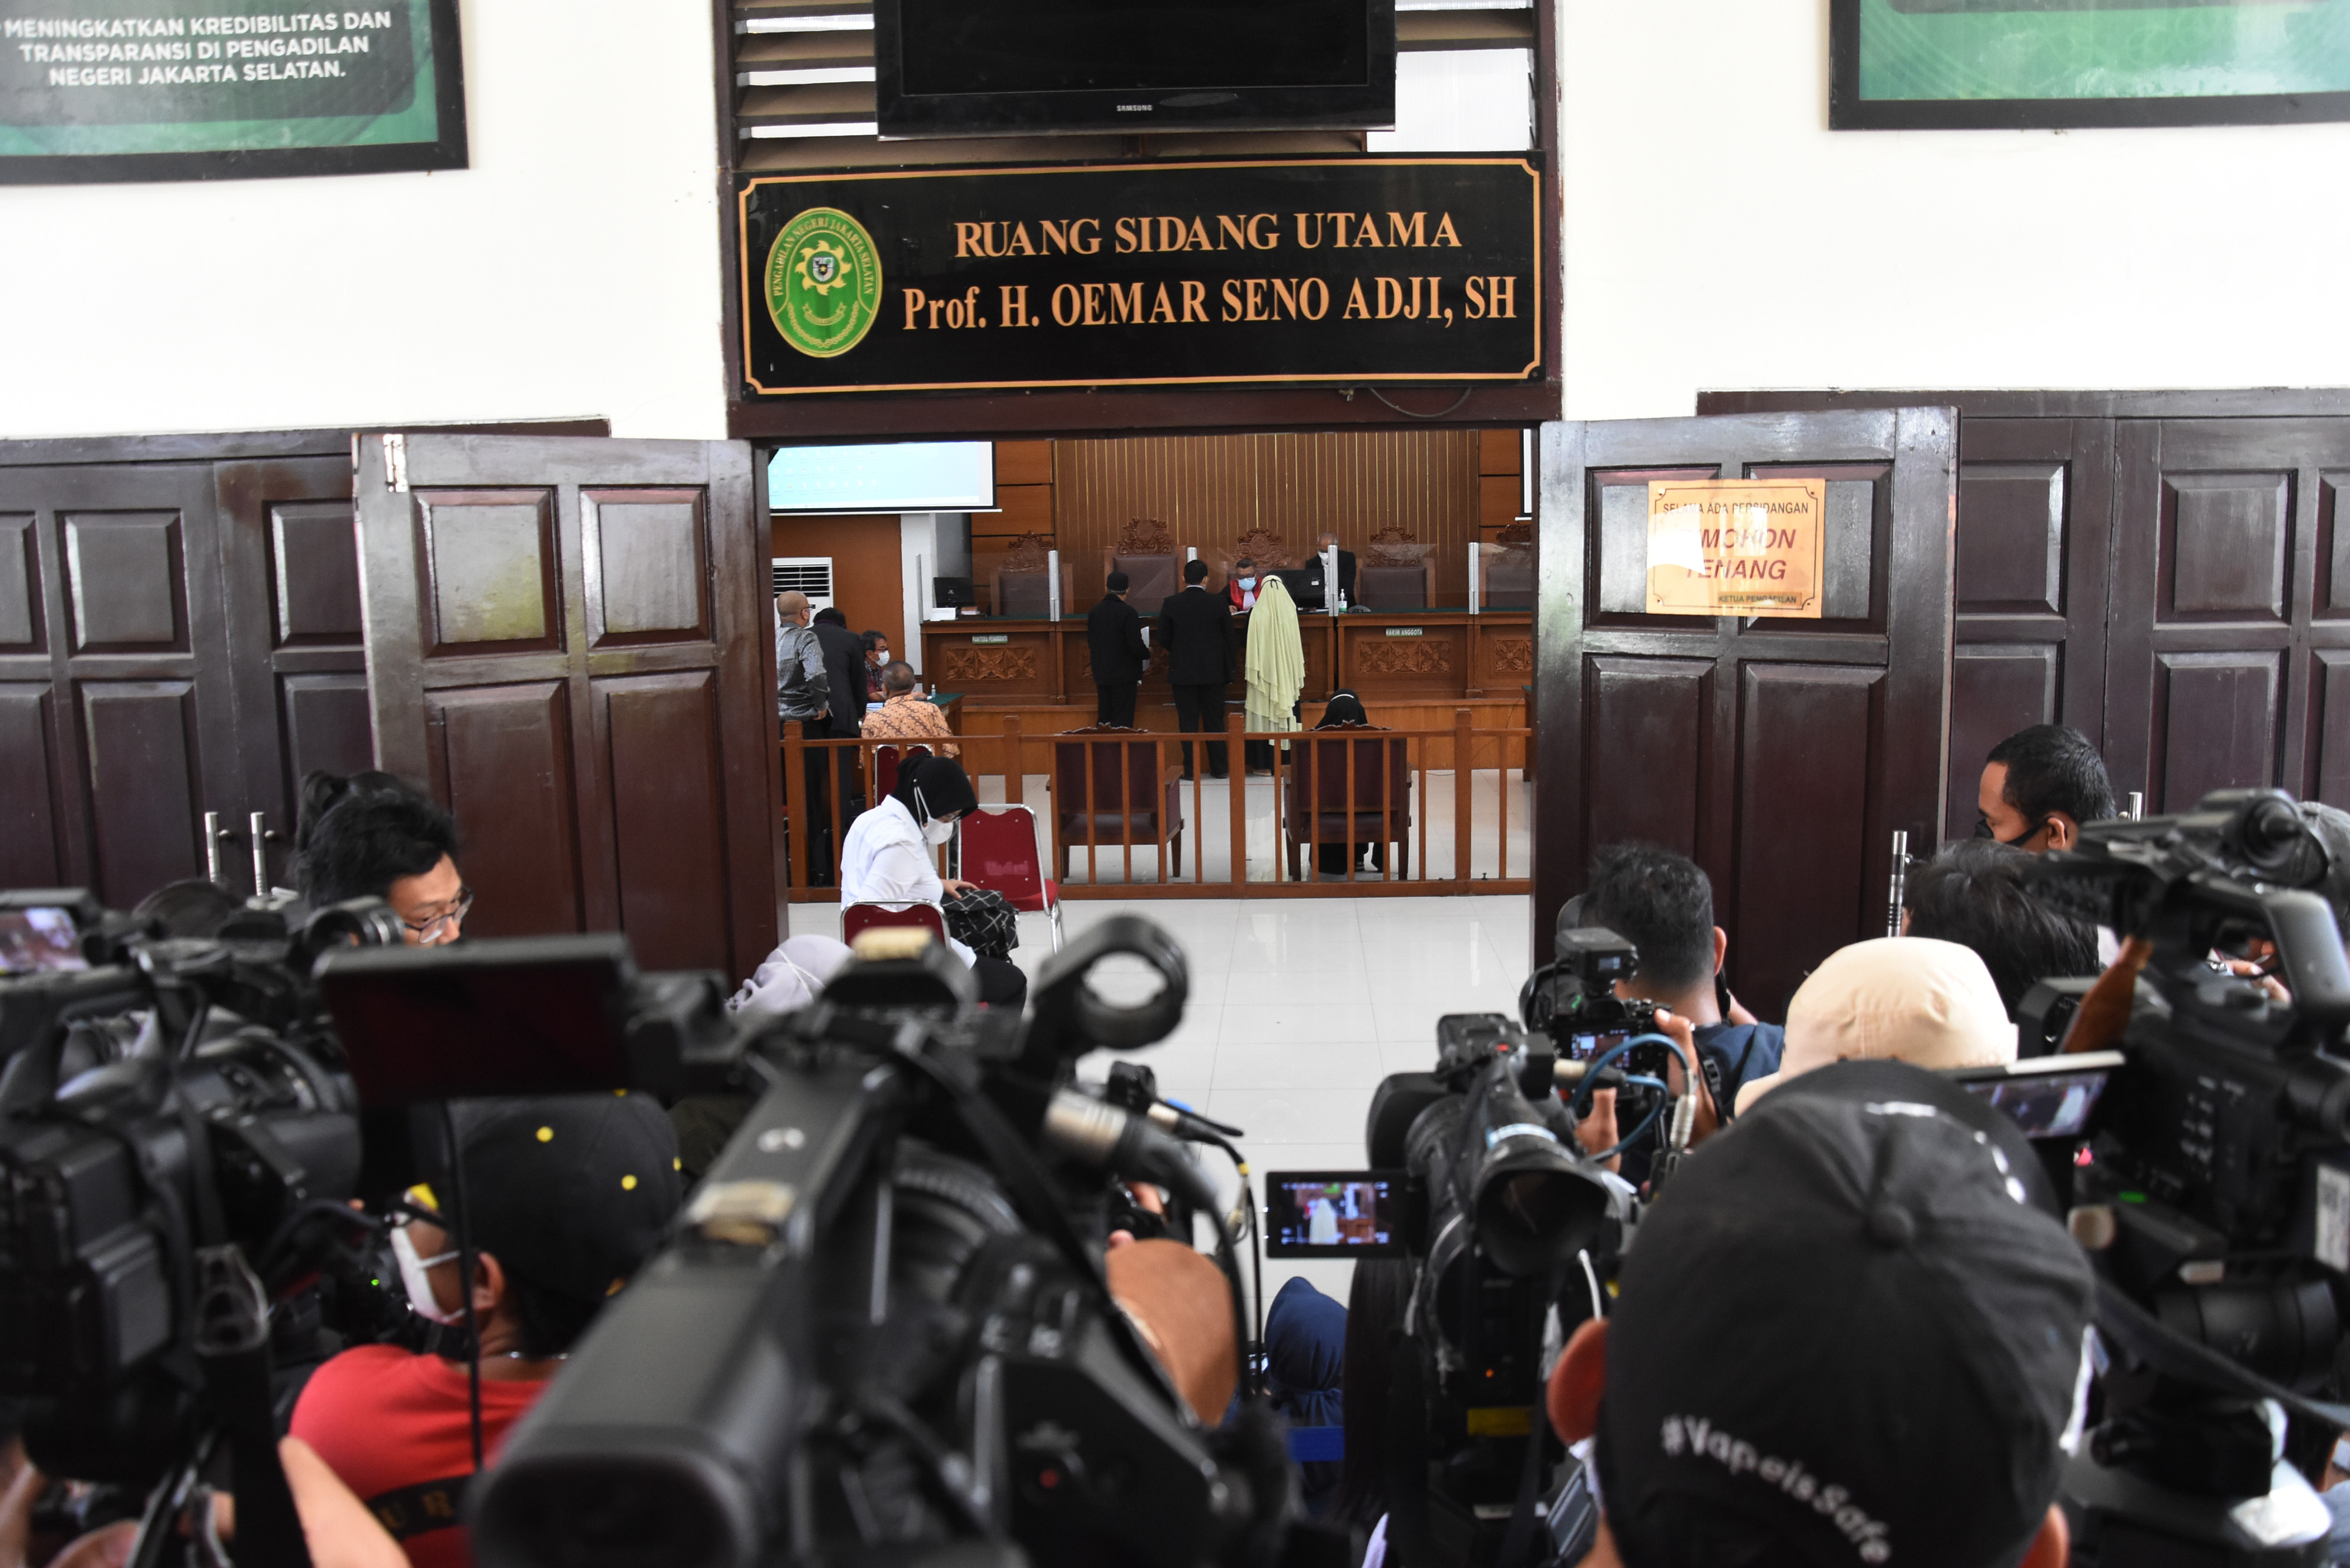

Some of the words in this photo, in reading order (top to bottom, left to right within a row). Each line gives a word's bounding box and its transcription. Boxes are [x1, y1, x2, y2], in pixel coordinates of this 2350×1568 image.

[5, 18, 185, 38] MENINGKATKAN
[190, 13, 338, 35] KREDIBILITAS
[344, 11, 391, 29] DAN
[19, 42, 192, 62] TRANSPARANSI
[197, 41, 220, 59] DI
[227, 36, 369, 58] PENGADILAN
[49, 66, 132, 86] NEGERI
[137, 64, 237, 84] JAKARTA
[243, 60, 346, 80] SELATAN.
[954, 219, 1102, 257] RUANG
[1115, 213, 1280, 253] SIDANG
[1294, 211, 1462, 249] UTAMA
[773, 236, 795, 296] PENGADILAN
[792, 217, 828, 240] NEGERI
[829, 218, 865, 253] JAKARTA
[860, 250, 875, 295] SELATAN
[902, 286, 986, 330] Prof.
[999, 286, 1039, 327] H.
[1052, 281, 1210, 327] OEMAR
[1222, 277, 1330, 322] SENO
[1342, 277, 1453, 328] ADJI,
[1465, 276, 1517, 319] SH
[1707, 503, 1728, 514] ADA
[1681, 529, 1796, 549] MOHON
